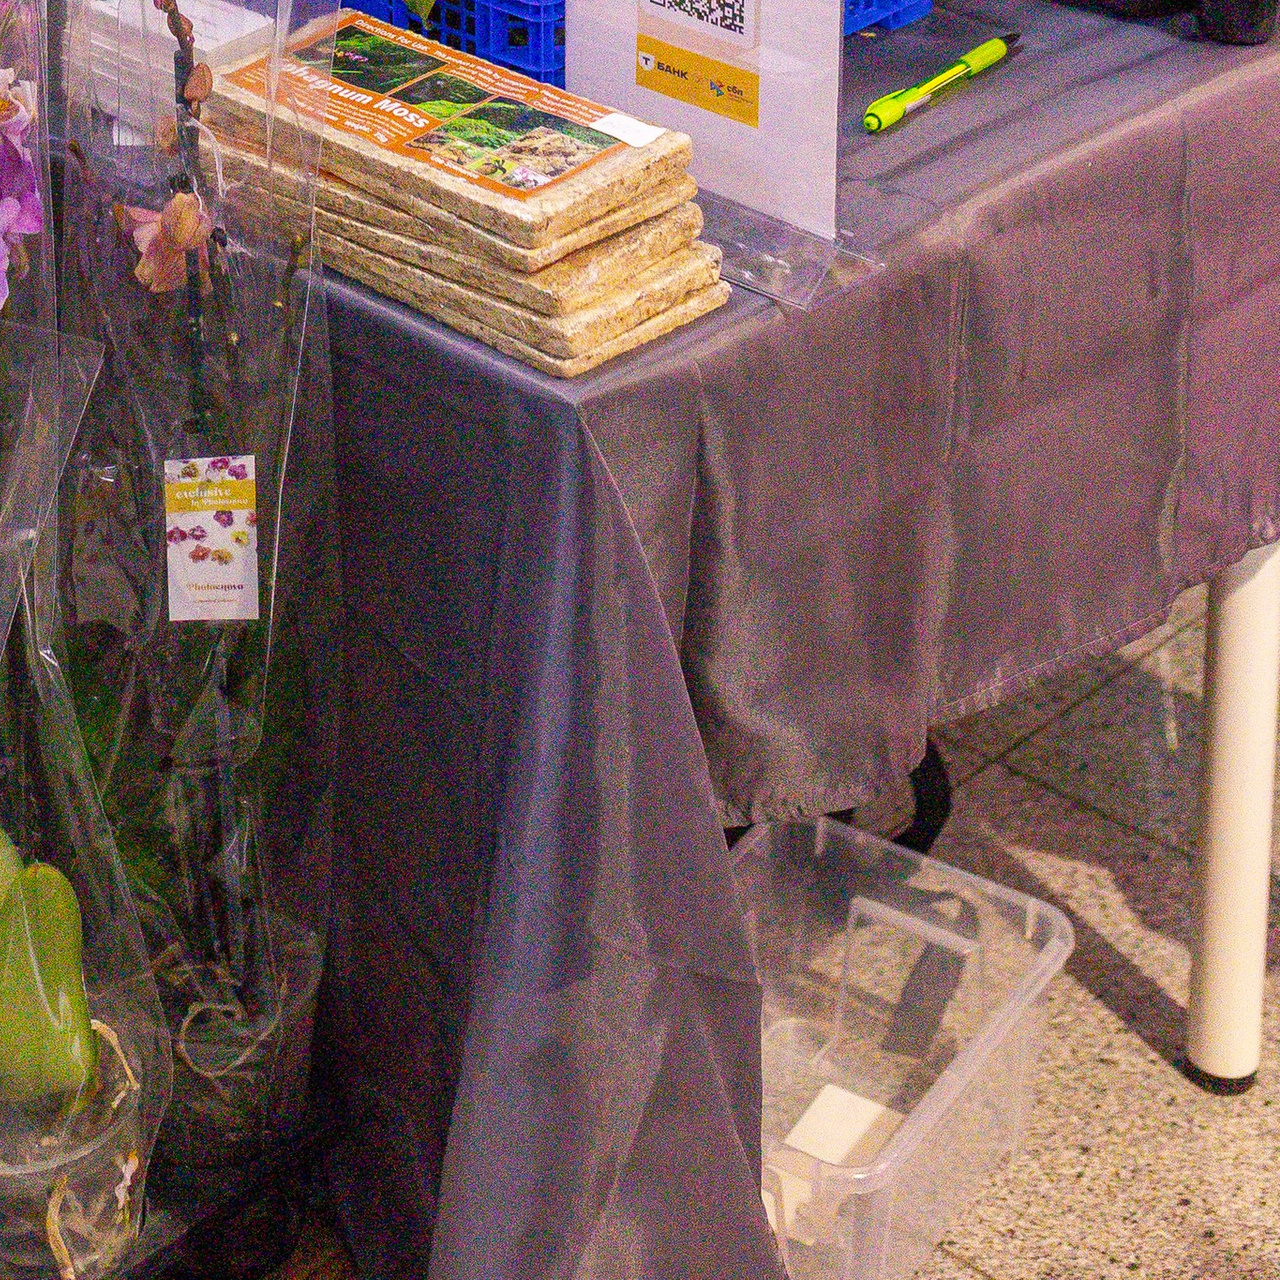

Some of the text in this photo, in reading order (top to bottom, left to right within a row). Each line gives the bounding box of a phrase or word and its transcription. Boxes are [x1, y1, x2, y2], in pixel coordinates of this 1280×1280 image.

[355, 19, 397, 39] Directions
[396, 35, 412, 45] For
[657, 61, 689, 81] БАНК
[274, 57, 373, 105] phagnum
[373, 98, 430, 129] Moss
[726, 84, 744, 97] сбп
[175, 486, 232, 500] exclusive
